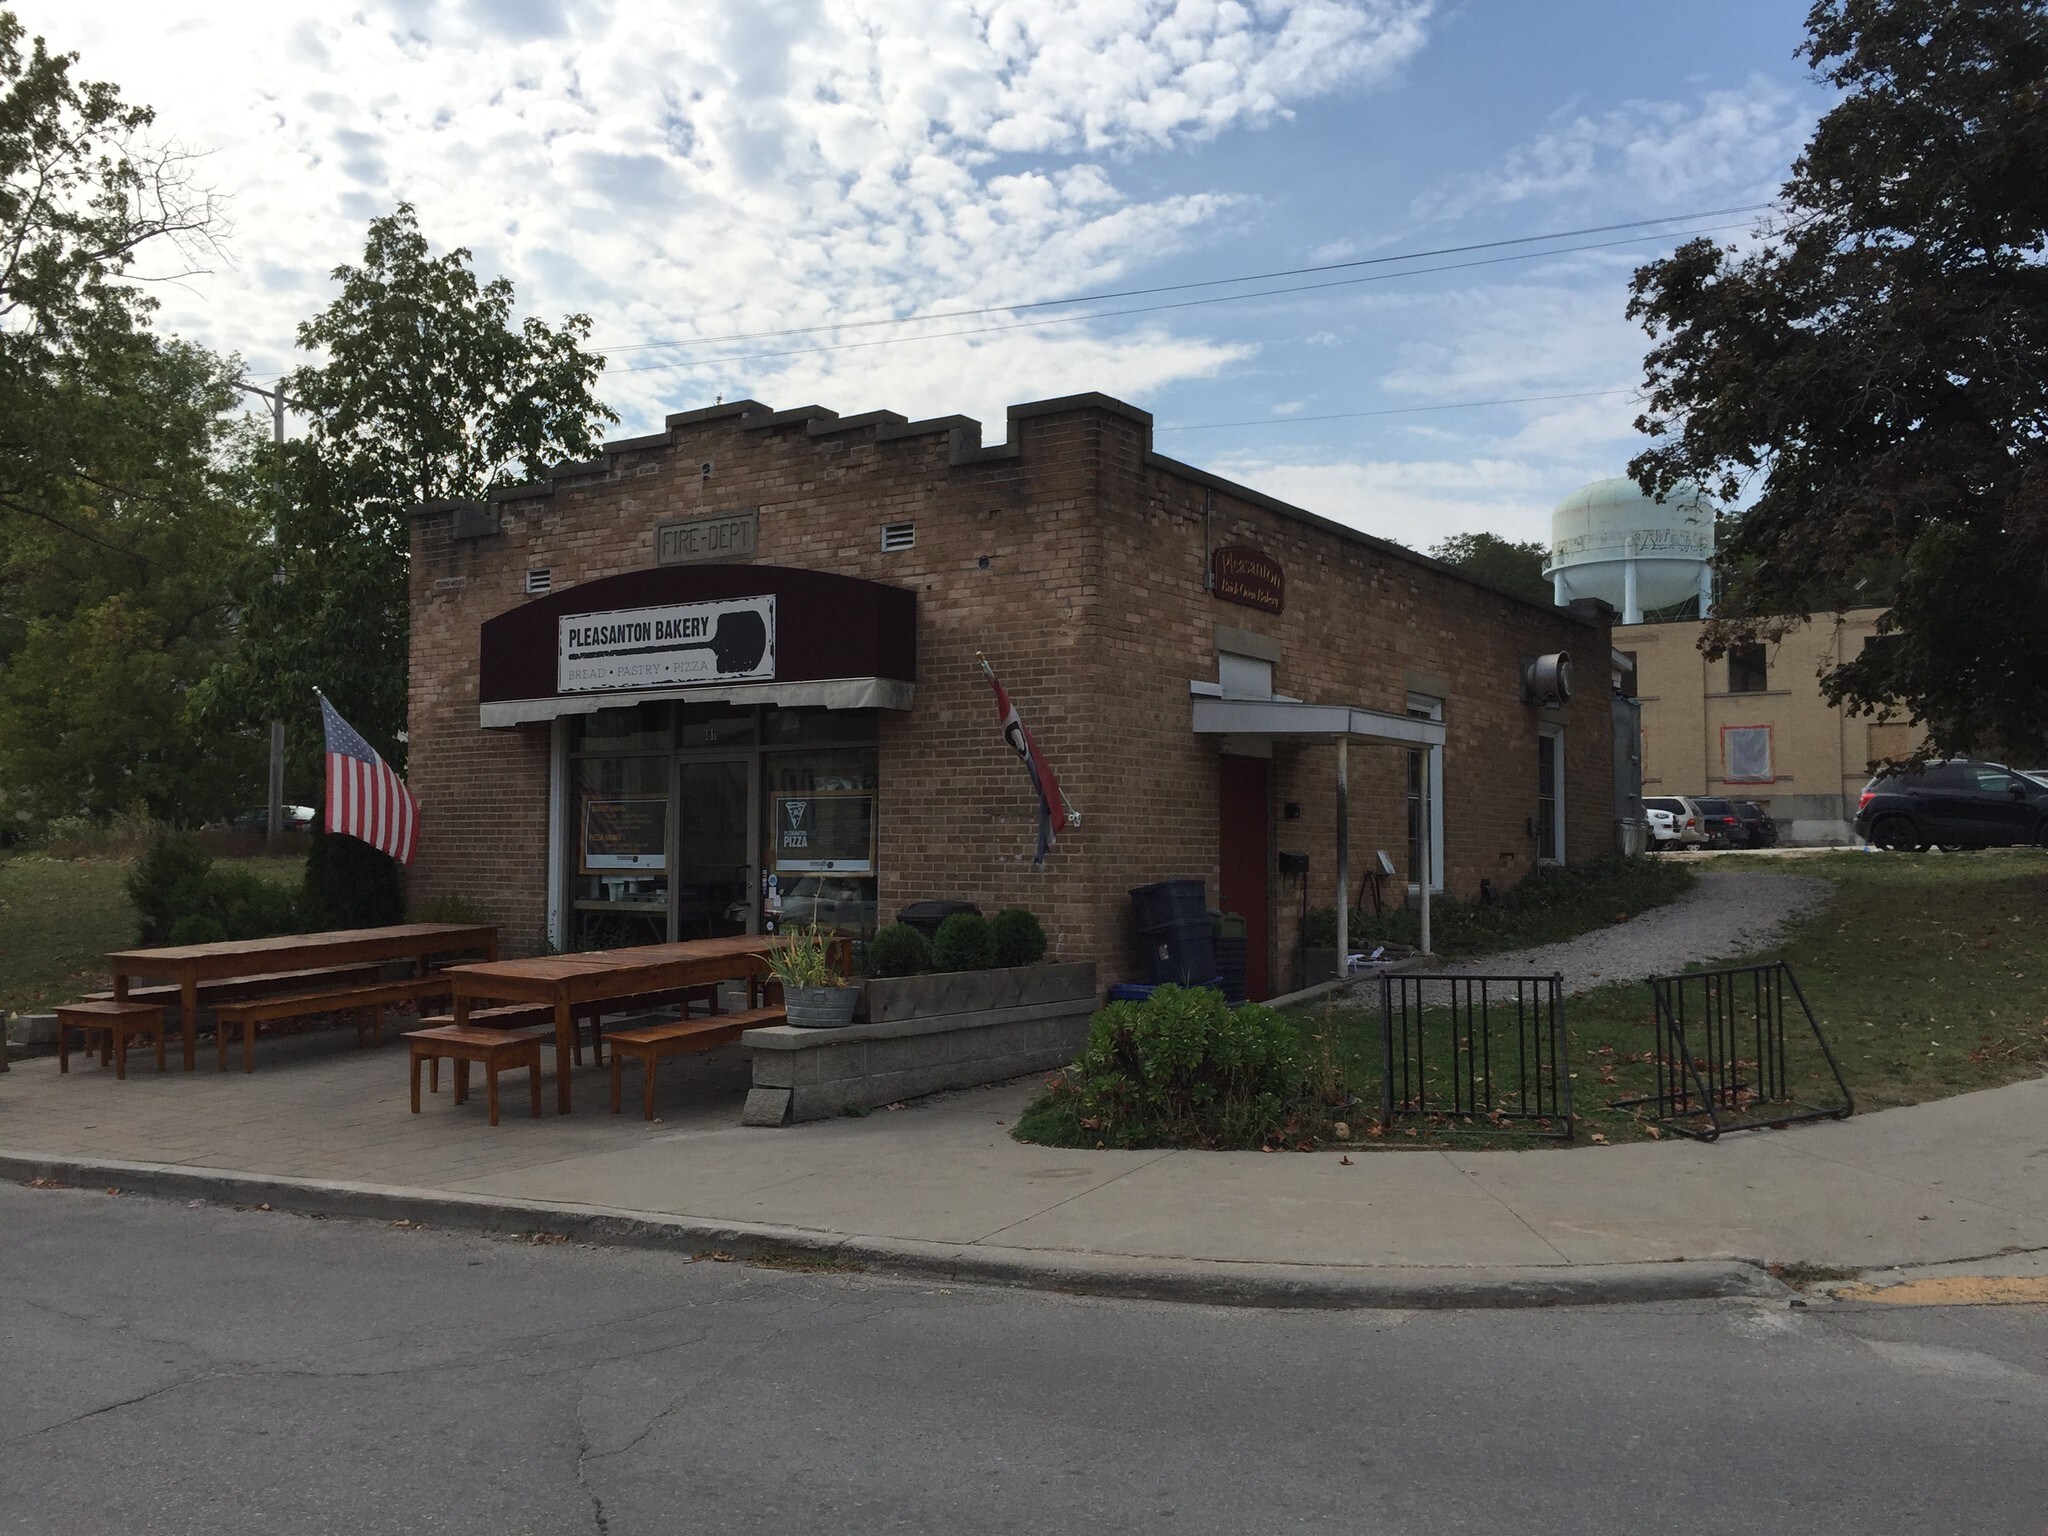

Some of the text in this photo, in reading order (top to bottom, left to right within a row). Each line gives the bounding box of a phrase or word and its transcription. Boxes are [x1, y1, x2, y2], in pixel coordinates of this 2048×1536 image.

[569, 616, 709, 647] PLEASANTON BAKERY
[568, 660, 708, 680] BREAD PASTRY PIZZA
[783, 836, 808, 848] PIZZA
